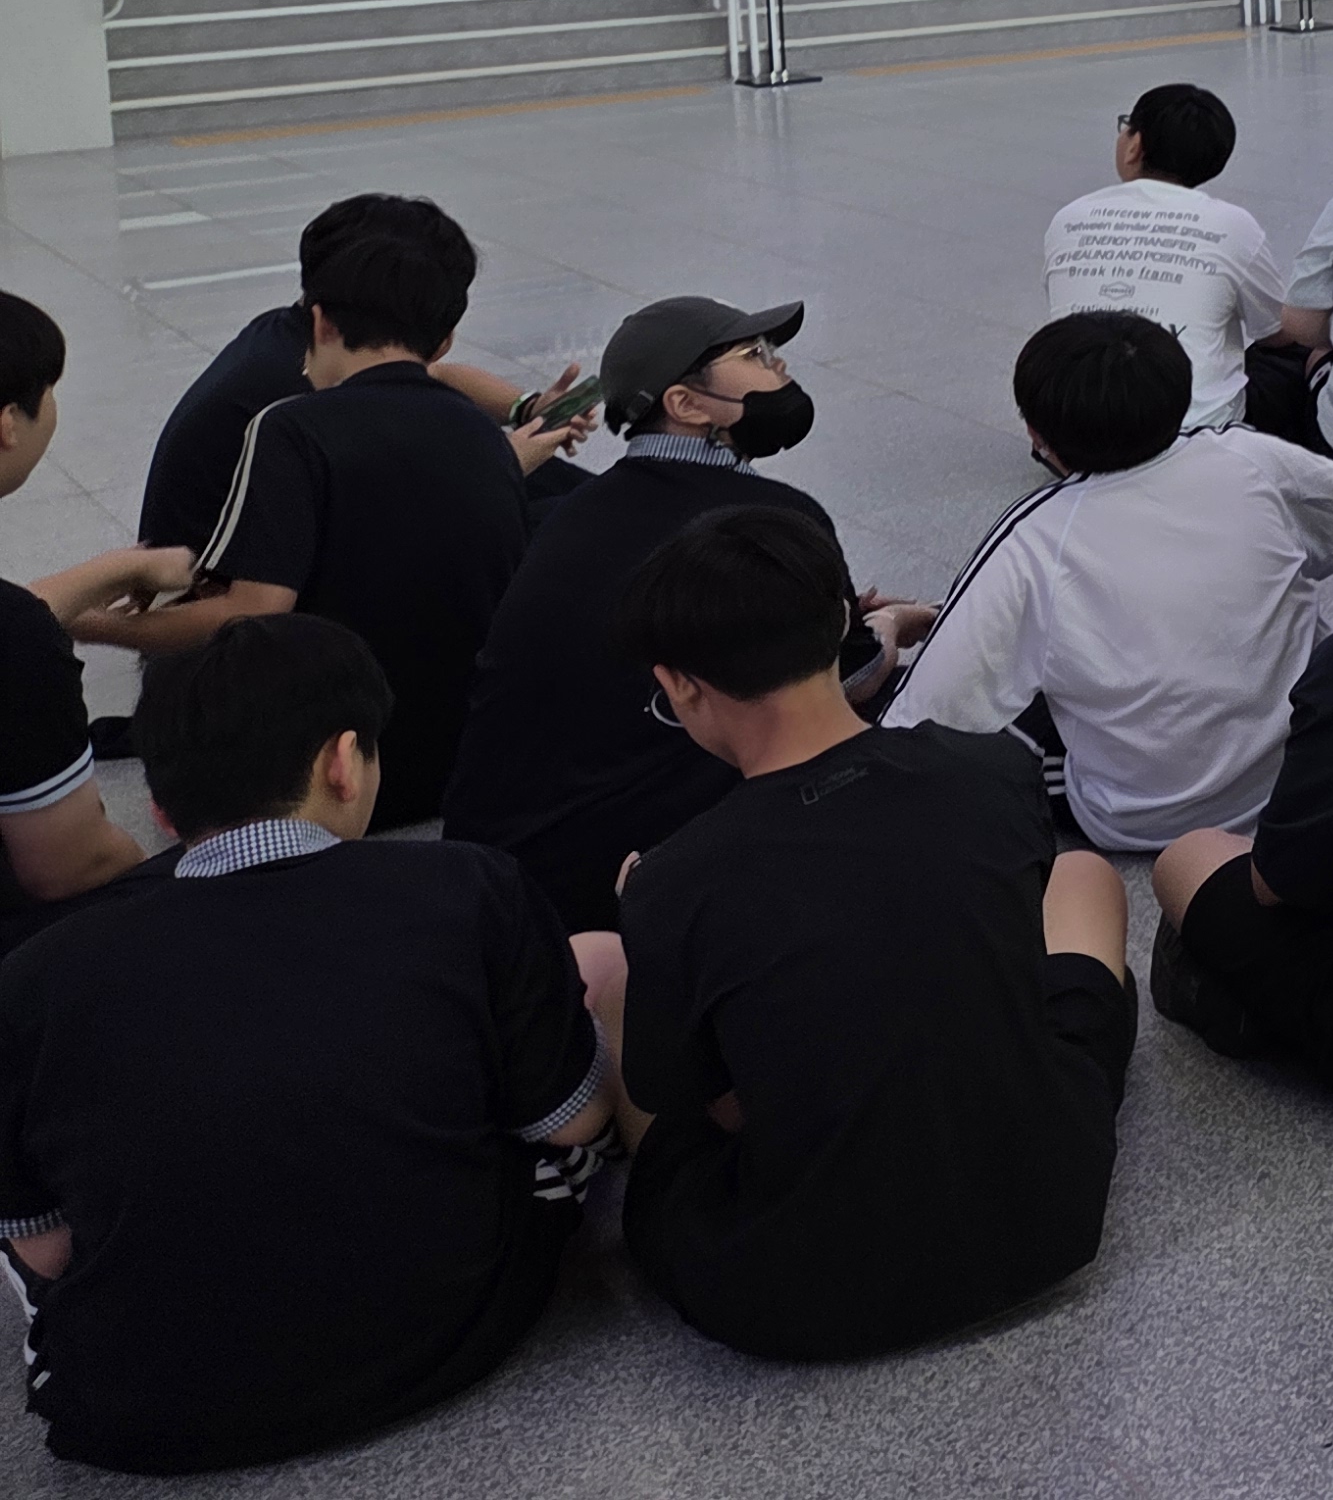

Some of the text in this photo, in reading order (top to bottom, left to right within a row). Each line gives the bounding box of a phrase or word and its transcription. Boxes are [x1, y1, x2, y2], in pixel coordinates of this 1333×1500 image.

[1089, 208, 1200, 223] intercrew means
[1113, 222, 1150, 232] similar
[1151, 224, 1179, 236] peer
[1134, 236, 1197, 252] TRANSFER
[1067, 250, 1114, 263] HEALING
[1116, 250, 1143, 261] AND
[1069, 266, 1184, 284] Break the frame
